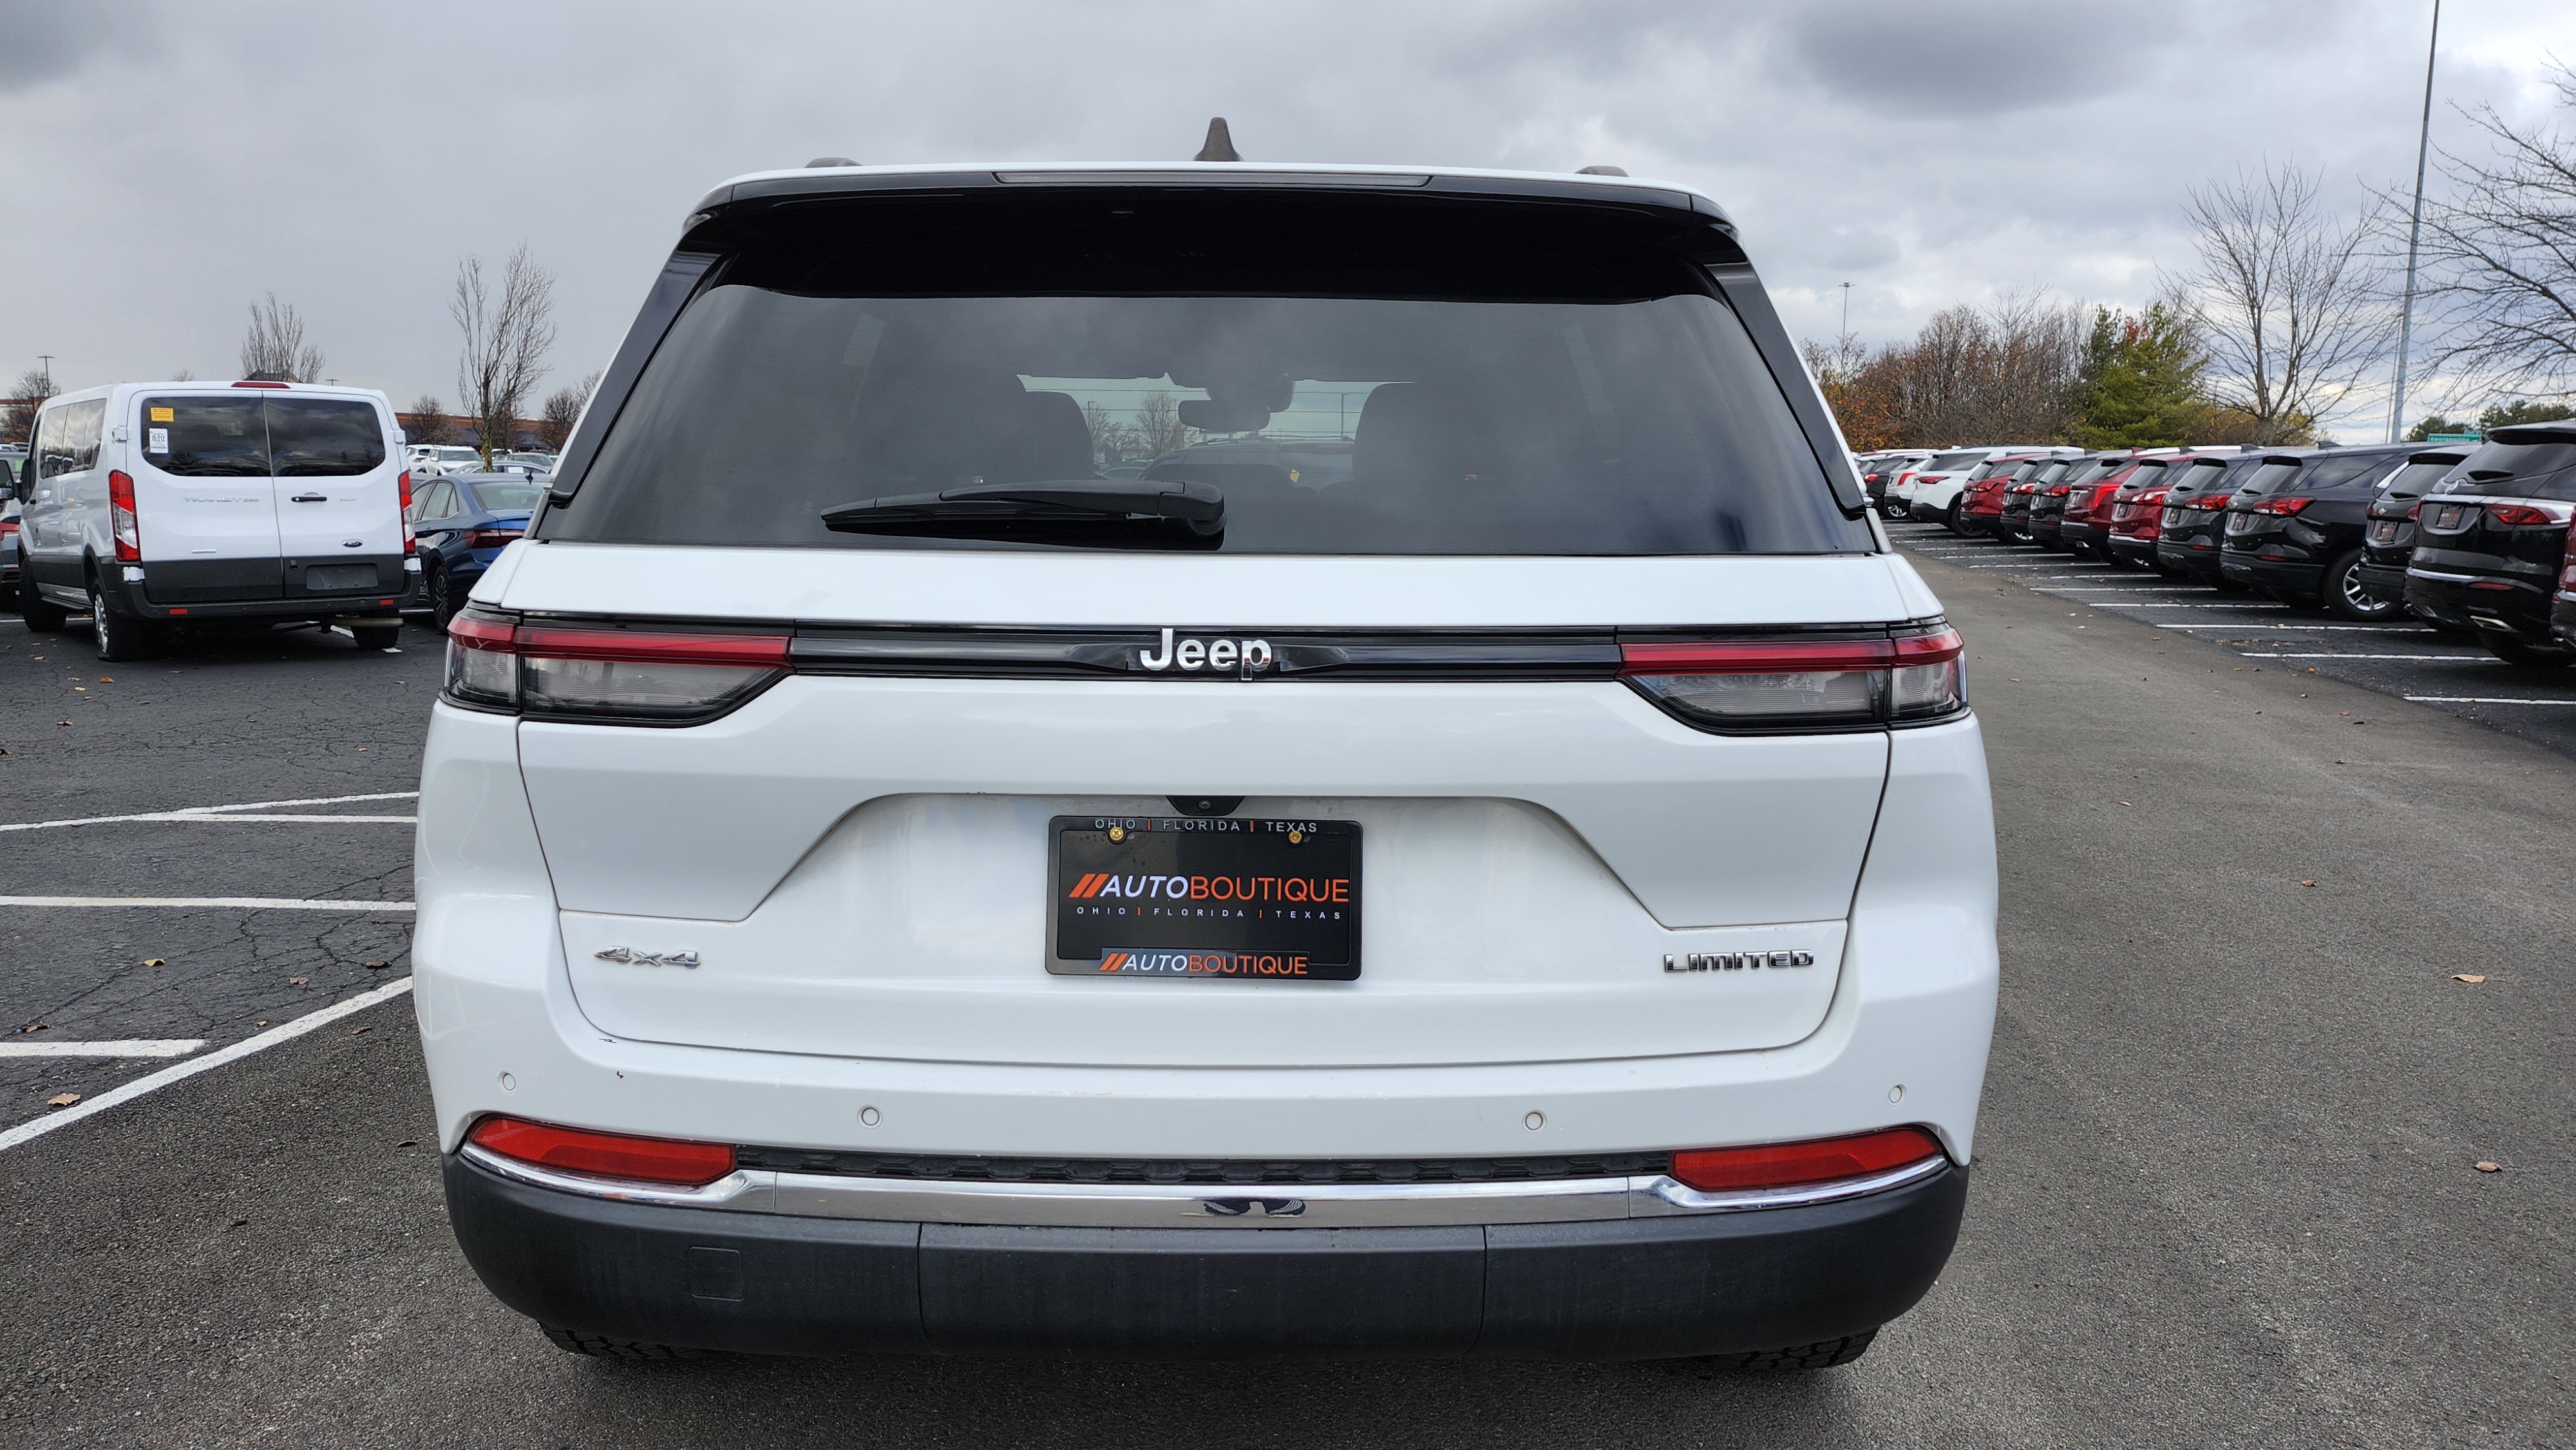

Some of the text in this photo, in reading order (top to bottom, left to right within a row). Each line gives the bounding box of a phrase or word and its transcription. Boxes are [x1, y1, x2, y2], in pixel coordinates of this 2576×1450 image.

[1139, 627, 1272, 681] Jeep
[1094, 818, 1317, 833] OHIO FLORIDA TEXAS
[1099, 874, 1349, 902] AUTOBOUTIQUE
[1153, 908, 1244, 917] FLORIDA
[1276, 910, 1340, 919] TEXAS
[594, 945, 701, 969] 4x4
[1121, 954, 1308, 975] AUTOBOUTIQUE
[1664, 949, 1814, 972] LIMITED
